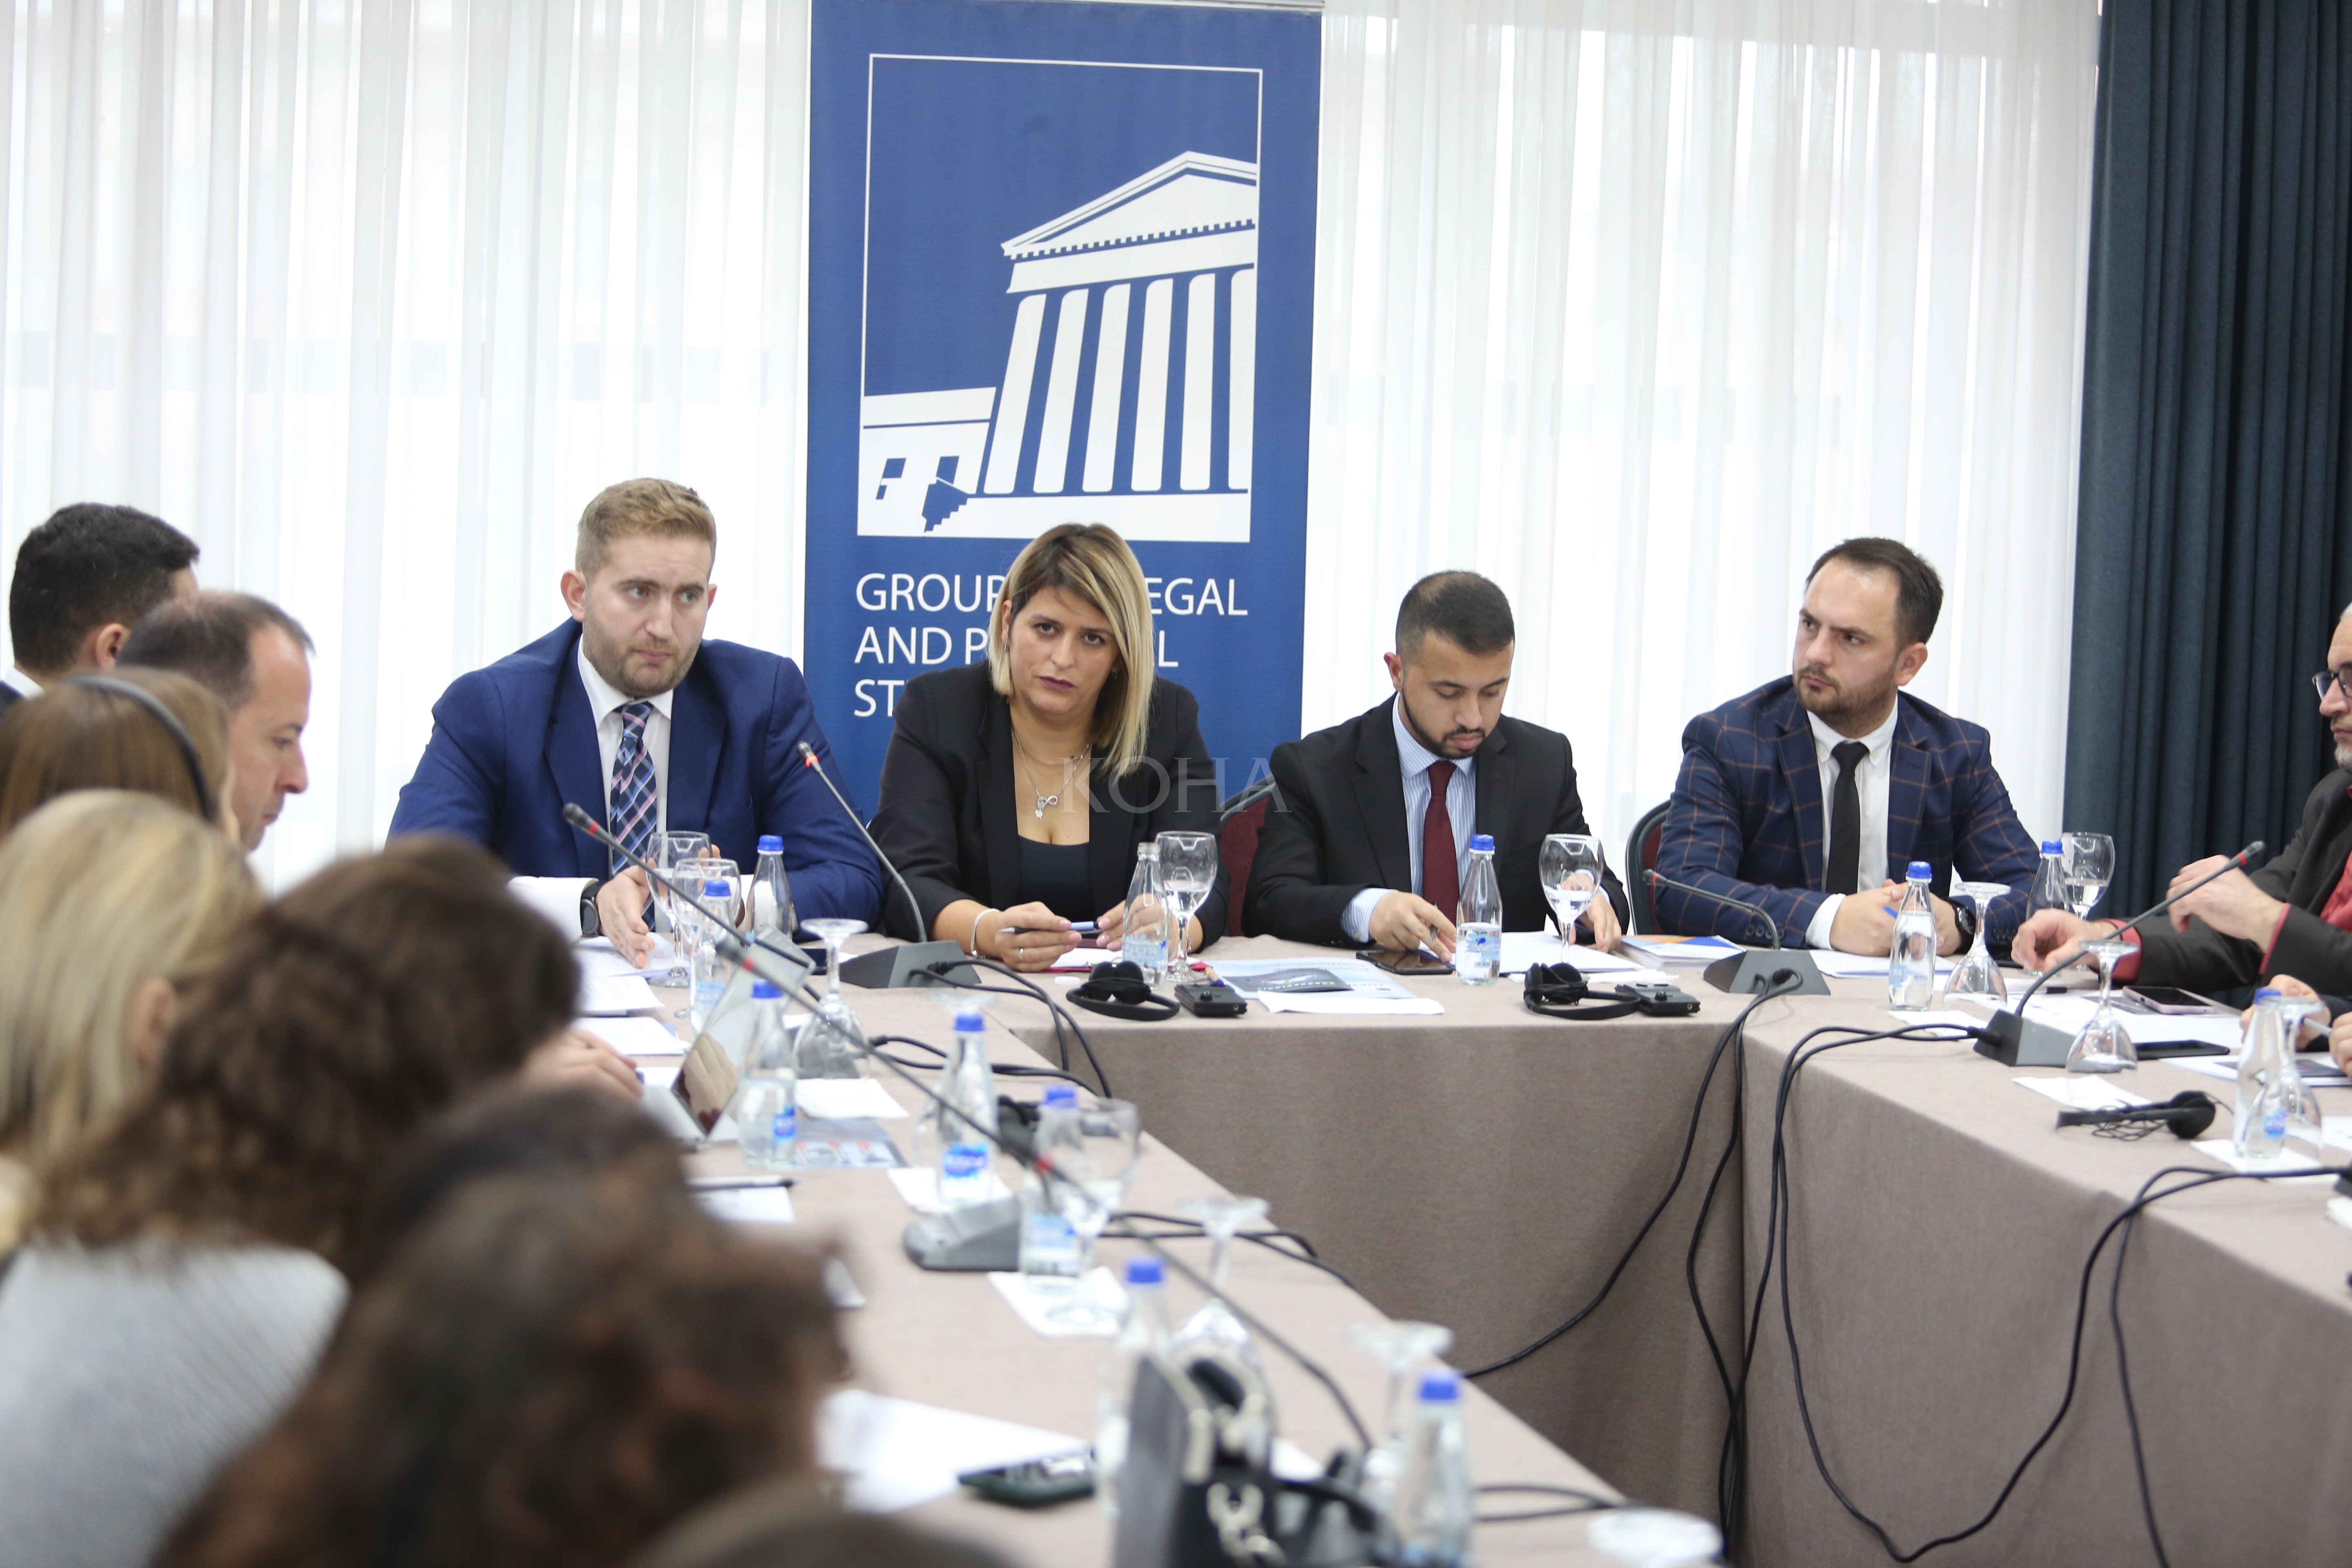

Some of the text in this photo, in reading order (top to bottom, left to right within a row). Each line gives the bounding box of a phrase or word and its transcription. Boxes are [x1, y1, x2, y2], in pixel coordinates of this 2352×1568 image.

[856, 572, 1248, 616] GROUP EGAL
[854, 626, 952, 665] AND
